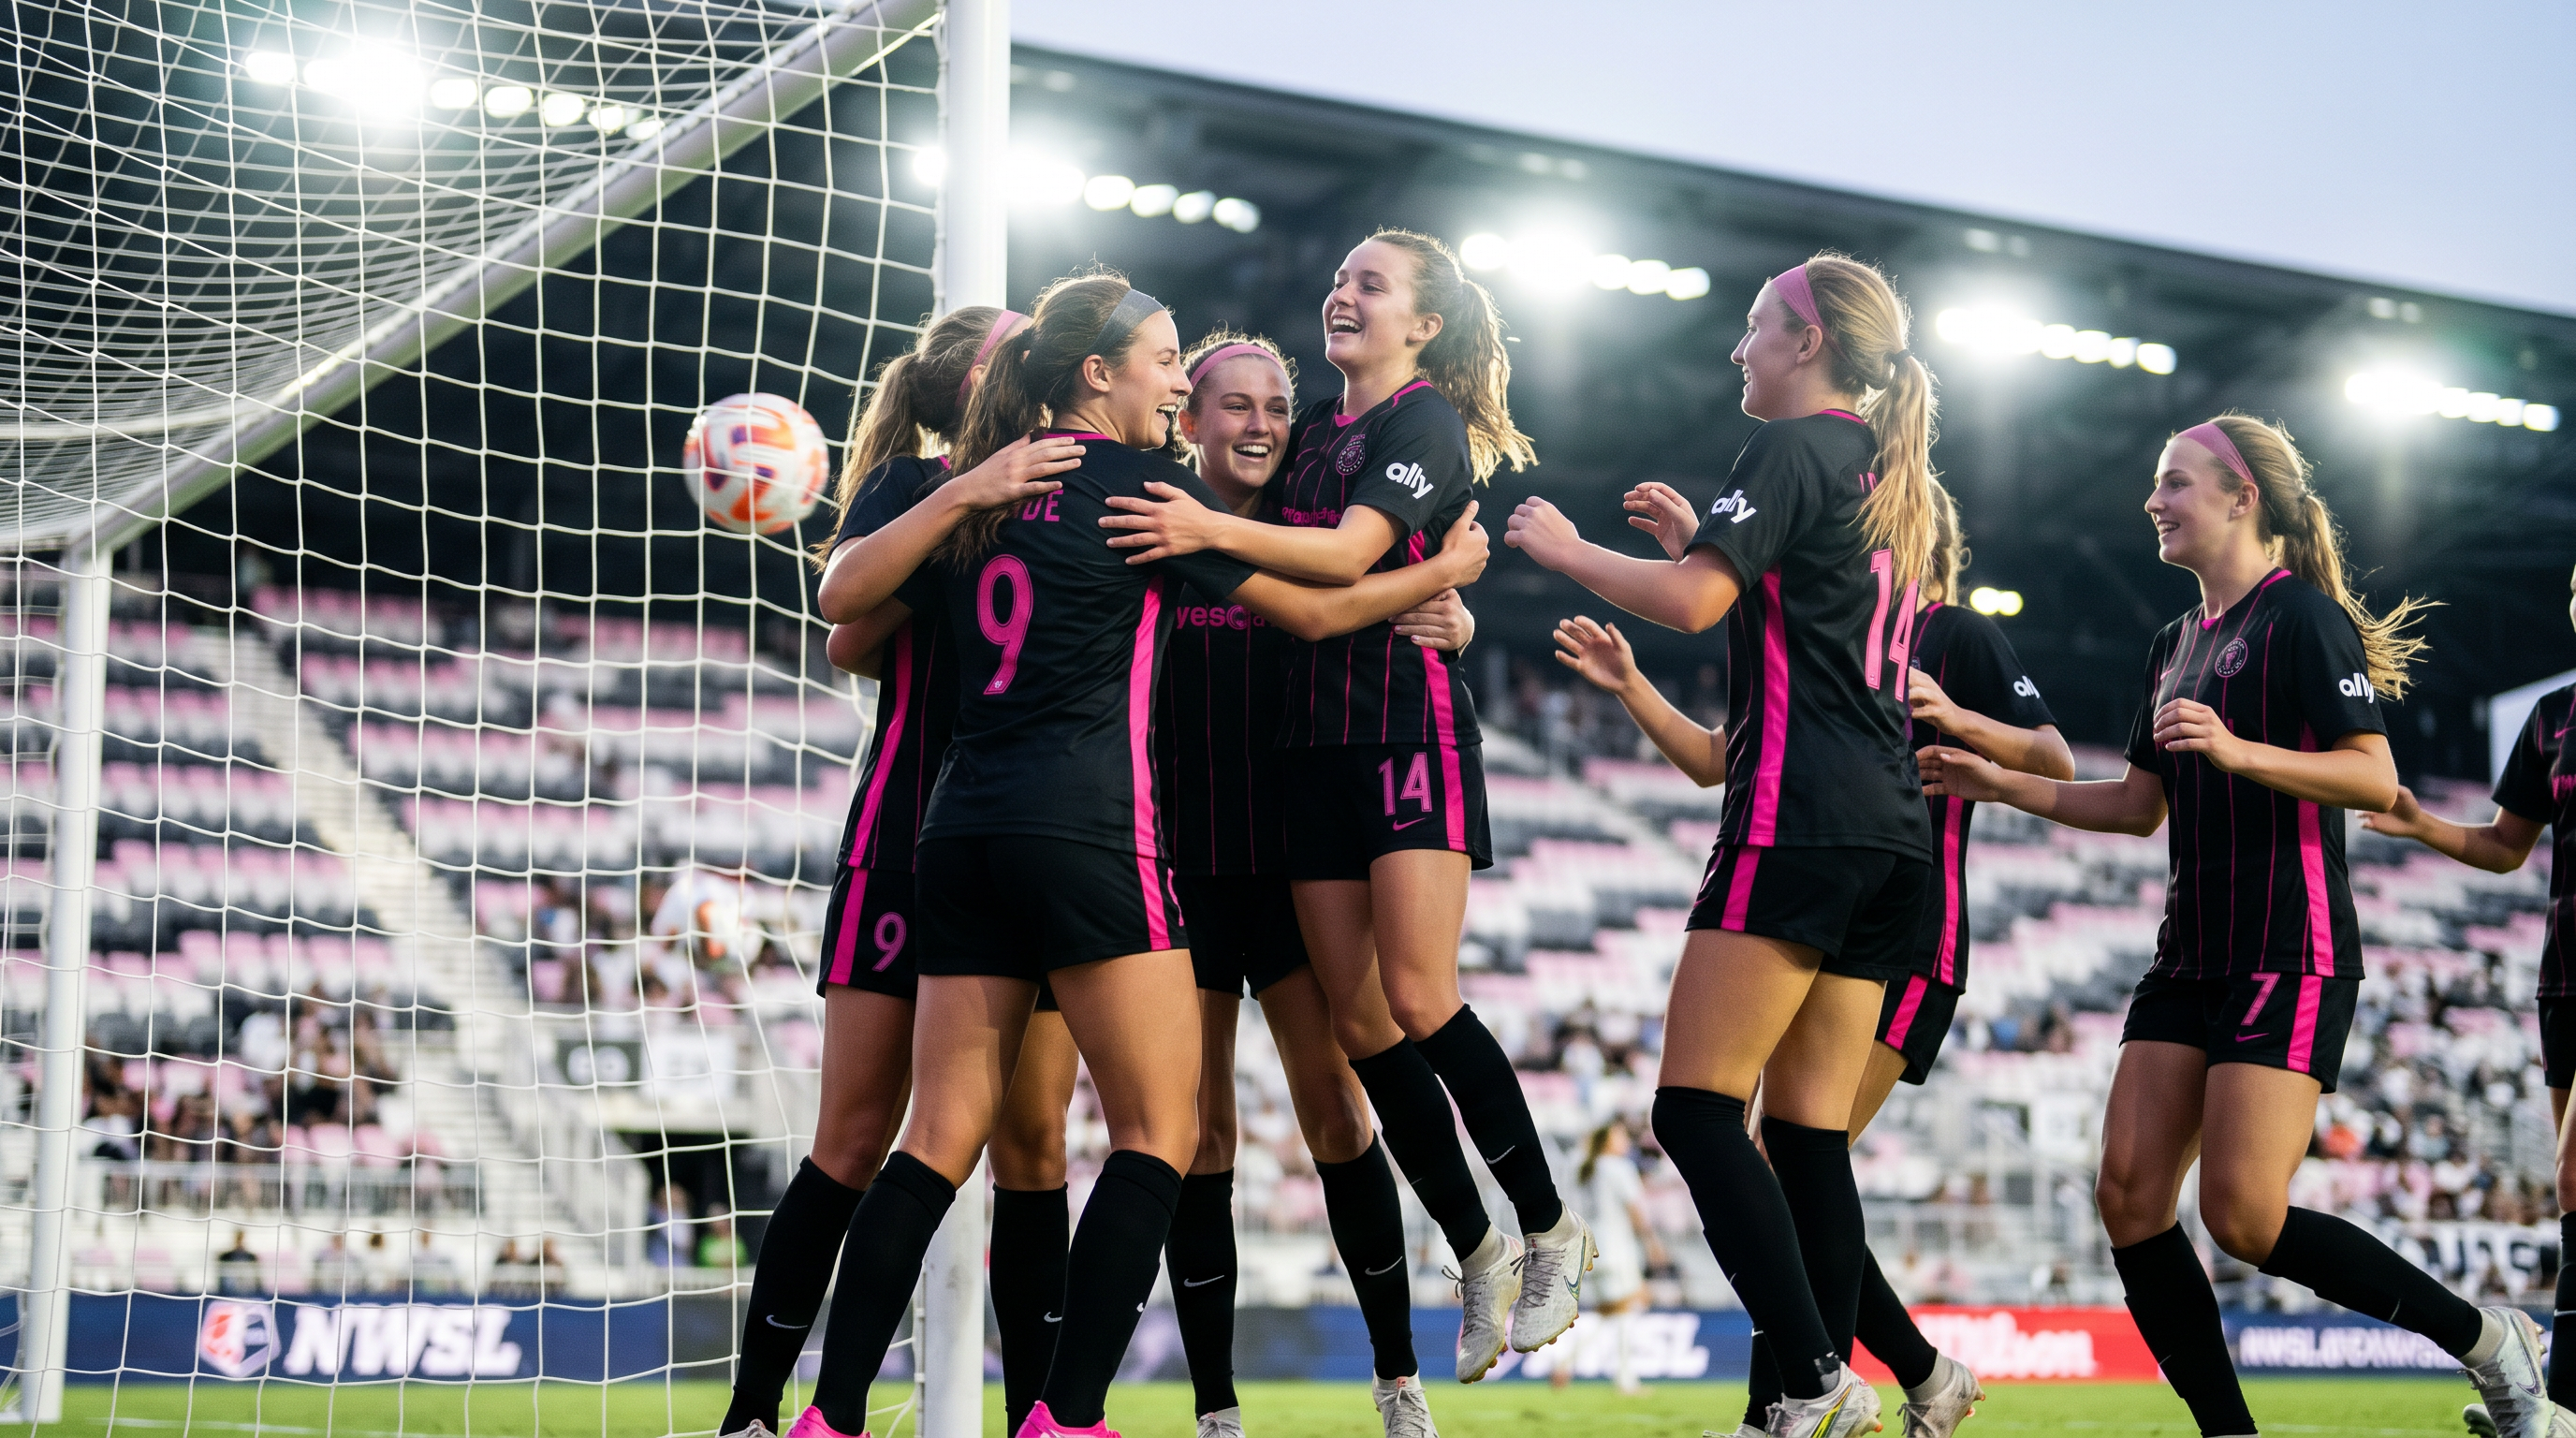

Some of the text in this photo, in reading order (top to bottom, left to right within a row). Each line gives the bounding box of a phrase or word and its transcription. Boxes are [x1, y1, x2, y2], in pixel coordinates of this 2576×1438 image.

[1385, 462, 1434, 500] ally
[1711, 489, 1757, 524] ally
[976, 553, 1034, 696] 9
[1865, 548, 1919, 703] 14
[2338, 672, 2375, 704] ally
[1378, 752, 1433, 816] 14
[871, 911, 907, 973] 9
[2240, 972, 2281, 1026] 7
[284, 1303, 521, 1376] NWSL
